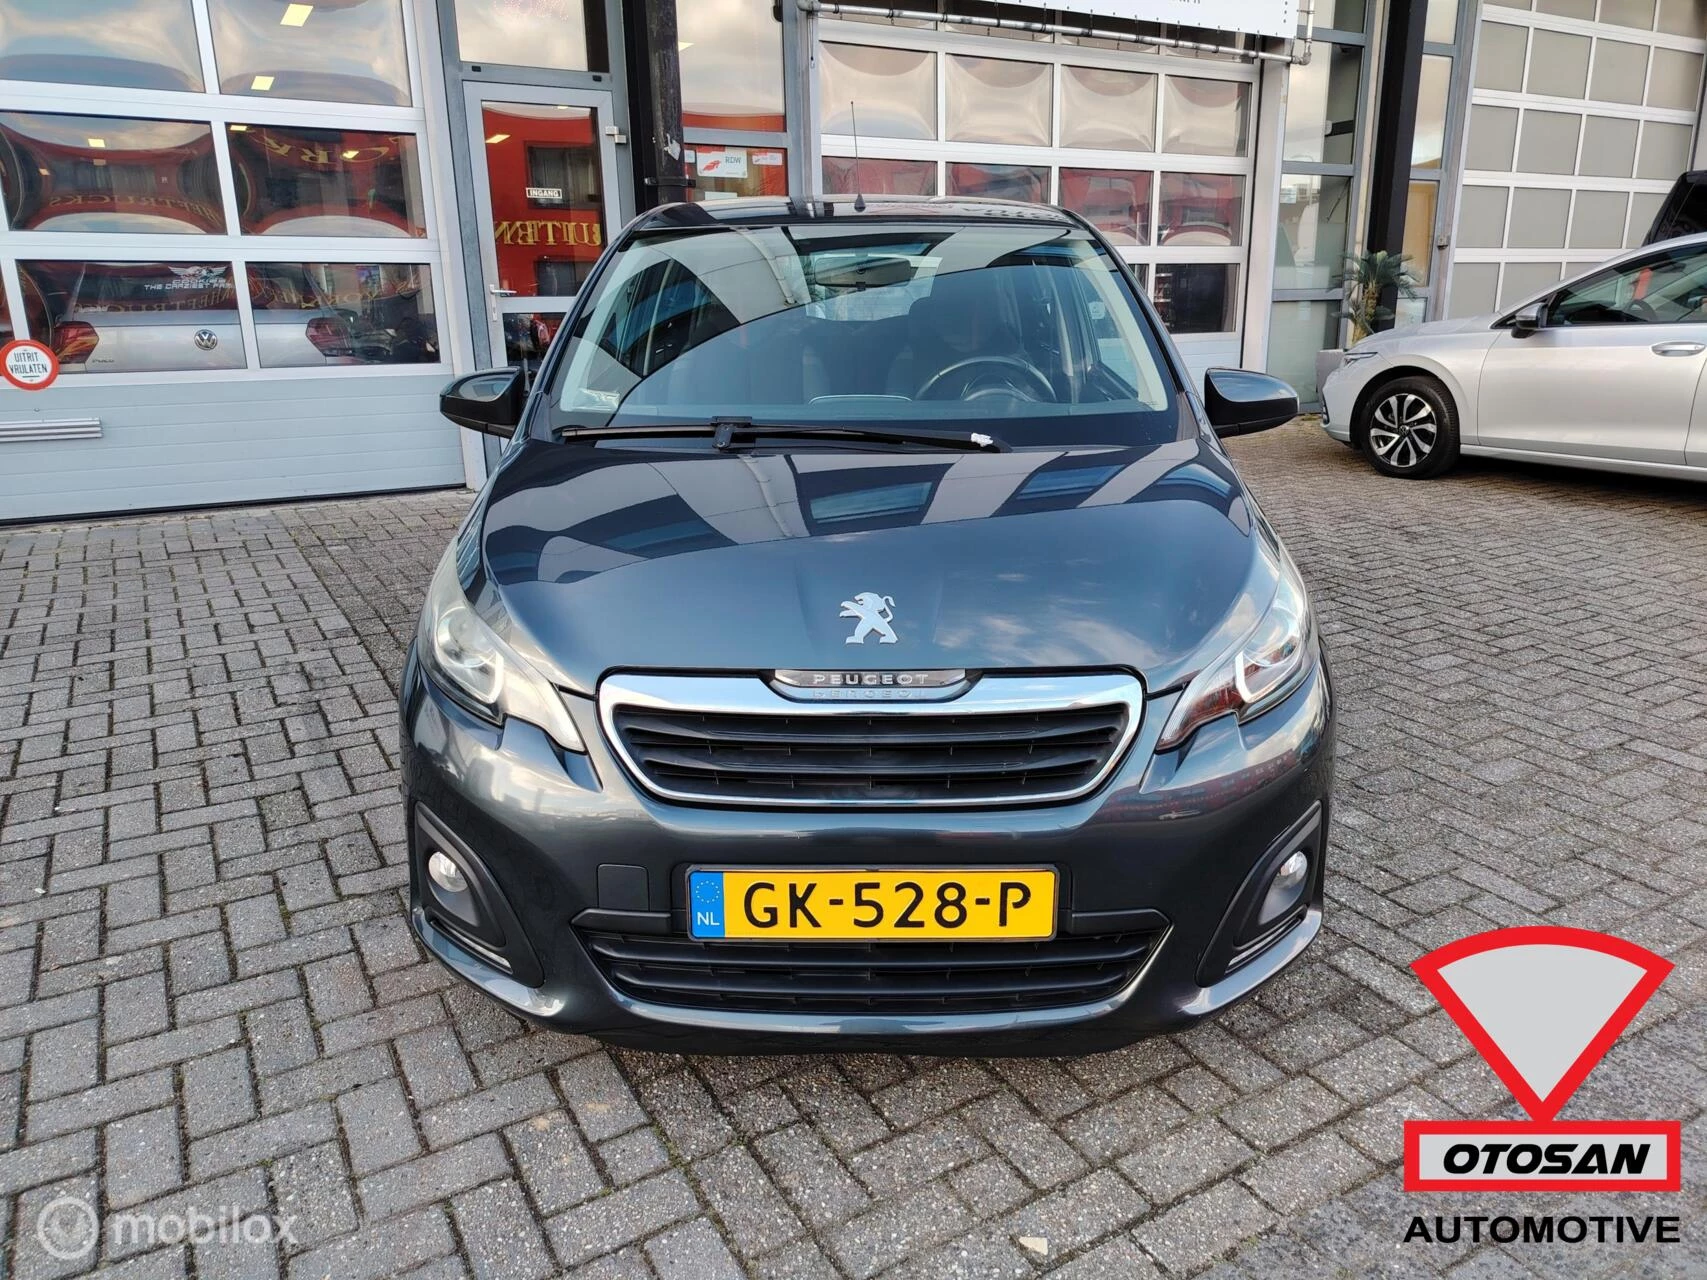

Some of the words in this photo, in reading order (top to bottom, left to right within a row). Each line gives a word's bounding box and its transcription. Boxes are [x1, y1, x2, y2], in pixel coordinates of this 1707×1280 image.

[725, 156, 741, 164] RDW
[14, 352, 38, 362] UITRIT
[9, 363, 48, 374] VRIJLATEN
[813, 674, 928, 685] PEUGEOT
[743, 881, 1031, 929] GK-528-P
[697, 911, 720, 926] NL
